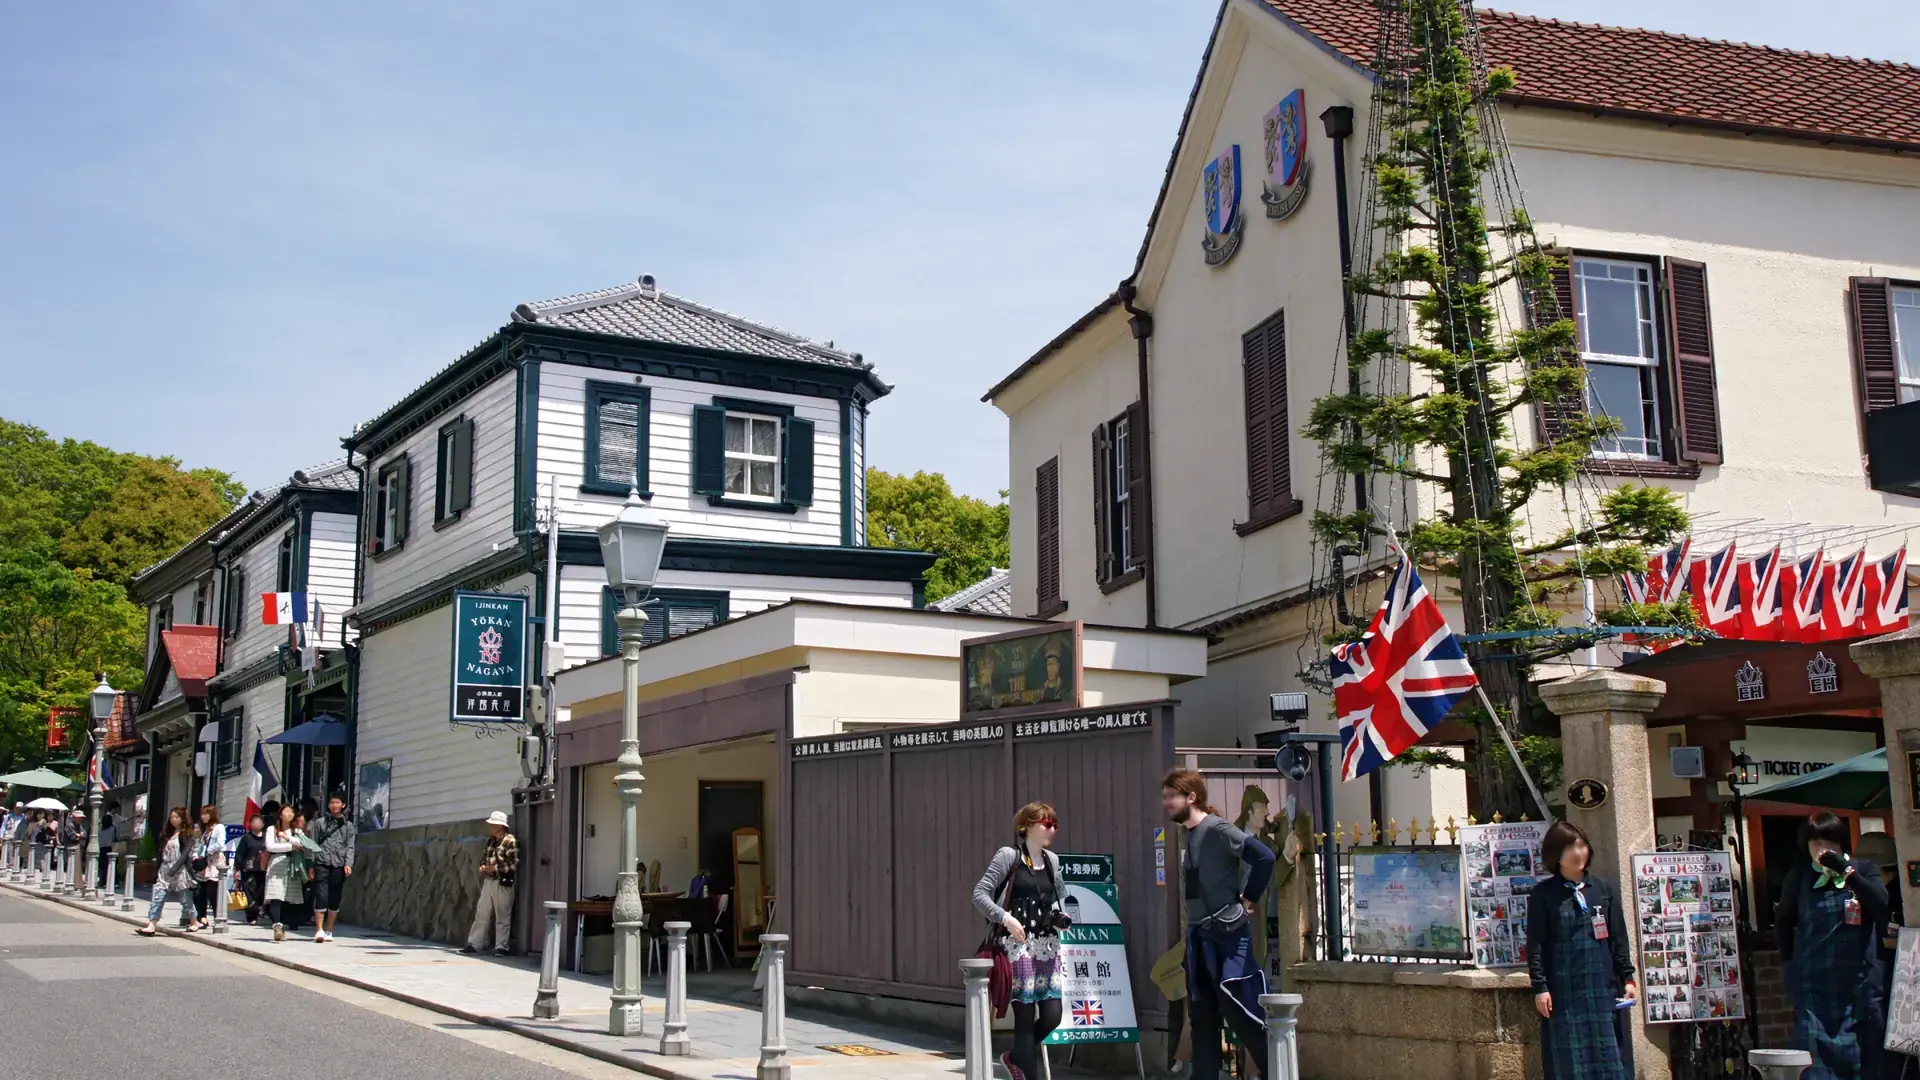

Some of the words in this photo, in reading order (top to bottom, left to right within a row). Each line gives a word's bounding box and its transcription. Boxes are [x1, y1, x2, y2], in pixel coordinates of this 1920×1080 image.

[475, 602, 509, 610] IJINKAN
[466, 662, 514, 676] NAGAYA
[467, 698, 511, 712] 洋館長屋
[1763, 760, 1801, 776] TICKET
[1687, 864, 1718, 873] うろこの家
[1062, 1030, 1119, 1041] うろこの家グループ
